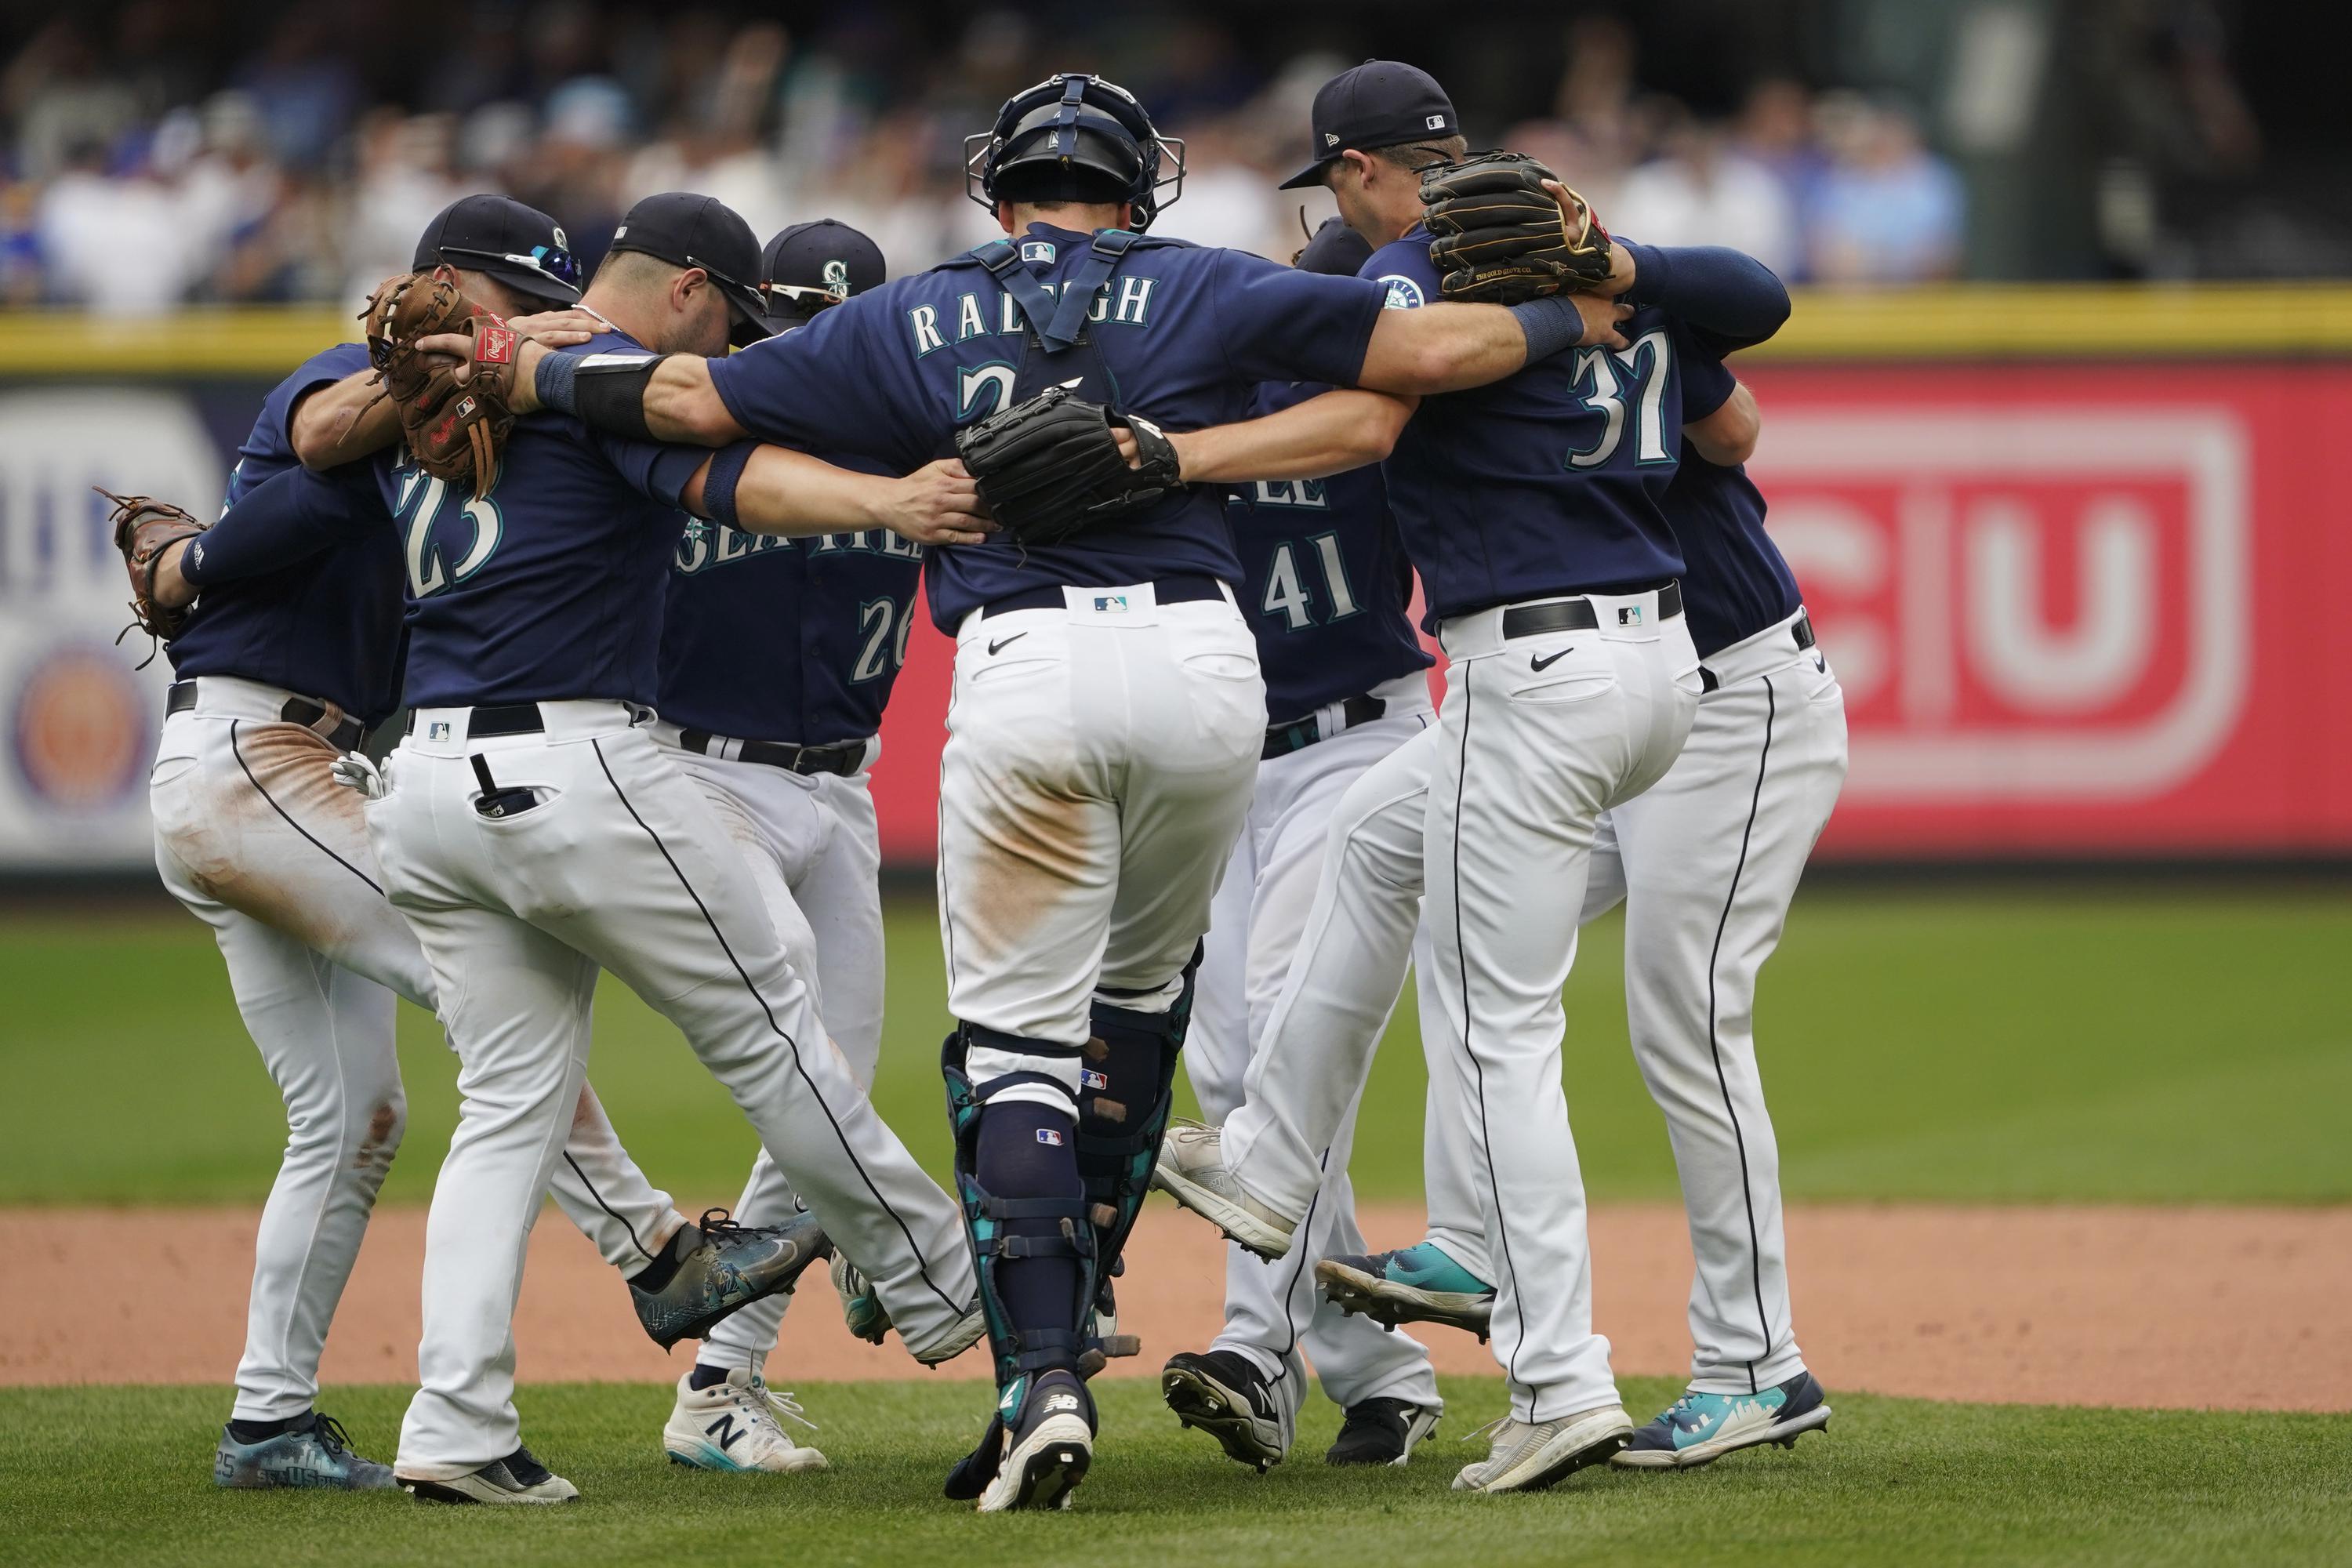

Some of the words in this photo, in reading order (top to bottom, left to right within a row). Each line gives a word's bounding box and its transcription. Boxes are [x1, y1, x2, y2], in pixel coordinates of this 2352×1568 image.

[822, 260, 851, 298] S
[1475, 272, 1487, 281] THE
[1487, 270, 1503, 278] GOLD
[908, 276, 1160, 359] RALGH
[1564, 326, 1678, 470] 37
[394, 453, 504, 601] 23
[1261, 530, 1368, 633] 41
[705, 1414, 748, 1451] N
